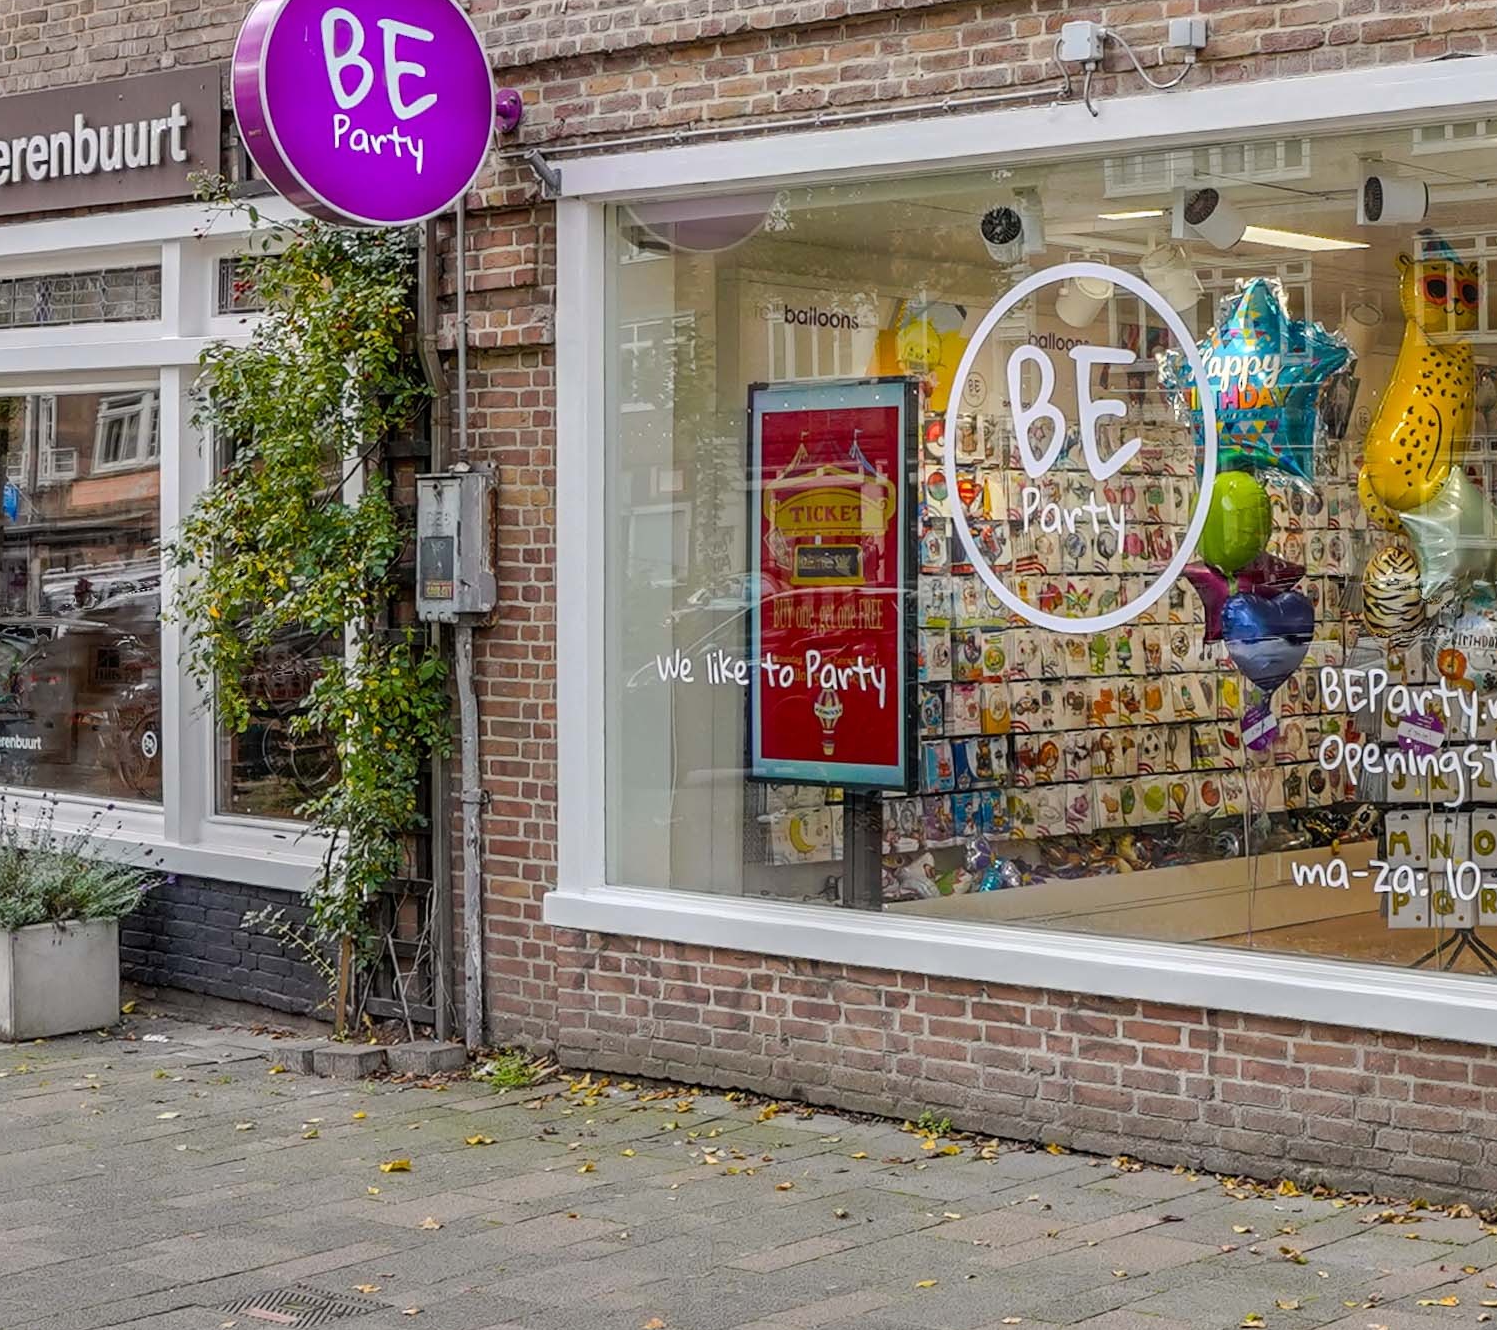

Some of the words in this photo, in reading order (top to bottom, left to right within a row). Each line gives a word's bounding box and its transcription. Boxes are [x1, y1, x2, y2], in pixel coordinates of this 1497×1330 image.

[321, 7, 438, 121] BE
[332, 113, 425, 174] Party
[784, 305, 859, 330] balloons
[1008, 345, 1142, 482] BE
[1022, 486, 1126, 554] Party
[773, 598, 793, 628] BUY
[858, 598, 883, 628] FREE
[656, 648, 694, 684] We
[706, 650, 749, 686] like
[761, 653, 794, 687] to
[805, 649, 886, 709] Party
[1389, 830, 1411, 857] M
[1292, 857, 1429, 900] ma-za:
